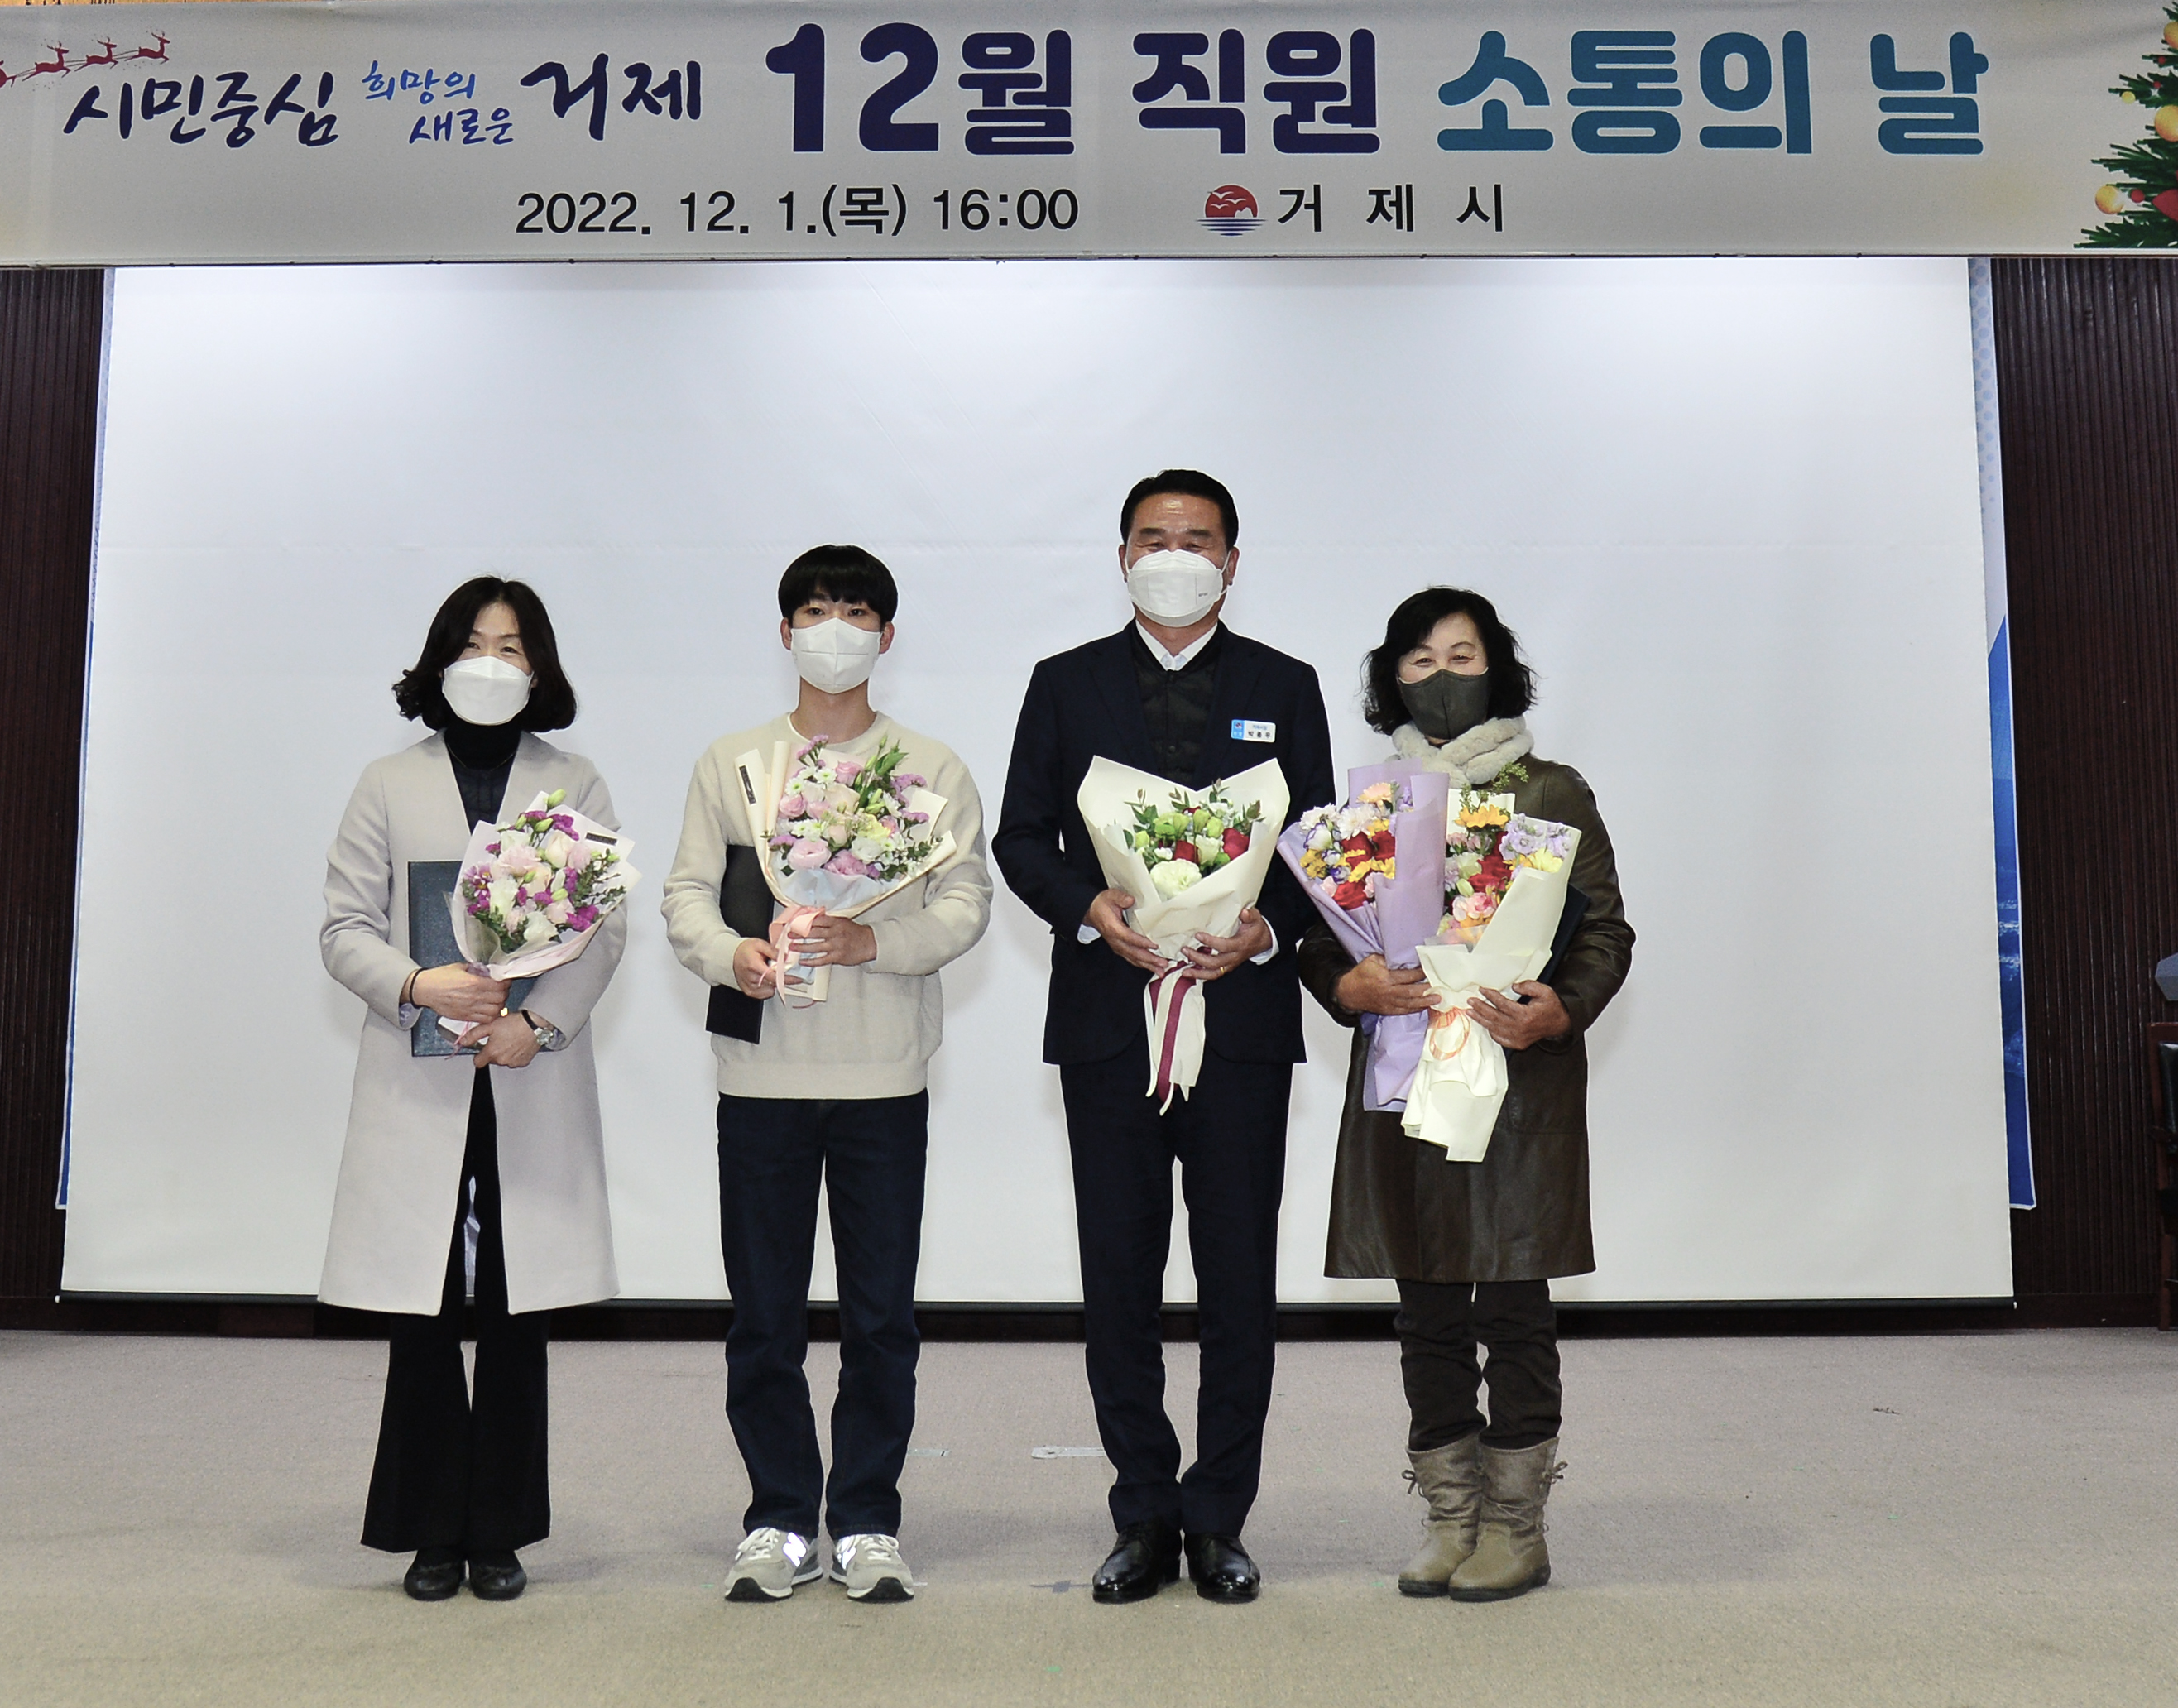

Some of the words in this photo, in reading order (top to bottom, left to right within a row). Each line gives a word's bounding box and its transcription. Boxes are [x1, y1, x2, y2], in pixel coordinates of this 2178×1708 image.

[63, 70, 339, 148] 시민중심
[361, 60, 477, 105] 희망의
[520, 52, 703, 142] 거제
[765, 22, 1076, 156] 12월
[1131, 28, 1381, 155] 직원
[1436, 30, 1813, 155] 소통의
[1869, 31, 1990, 155] 날
[408, 107, 515, 145] 새로운
[516, 191, 651, 235] 2022.
[679, 190, 750, 234] 12.
[778, 183, 908, 237] 1.(목)
[933, 188, 1080, 232] 16:00
